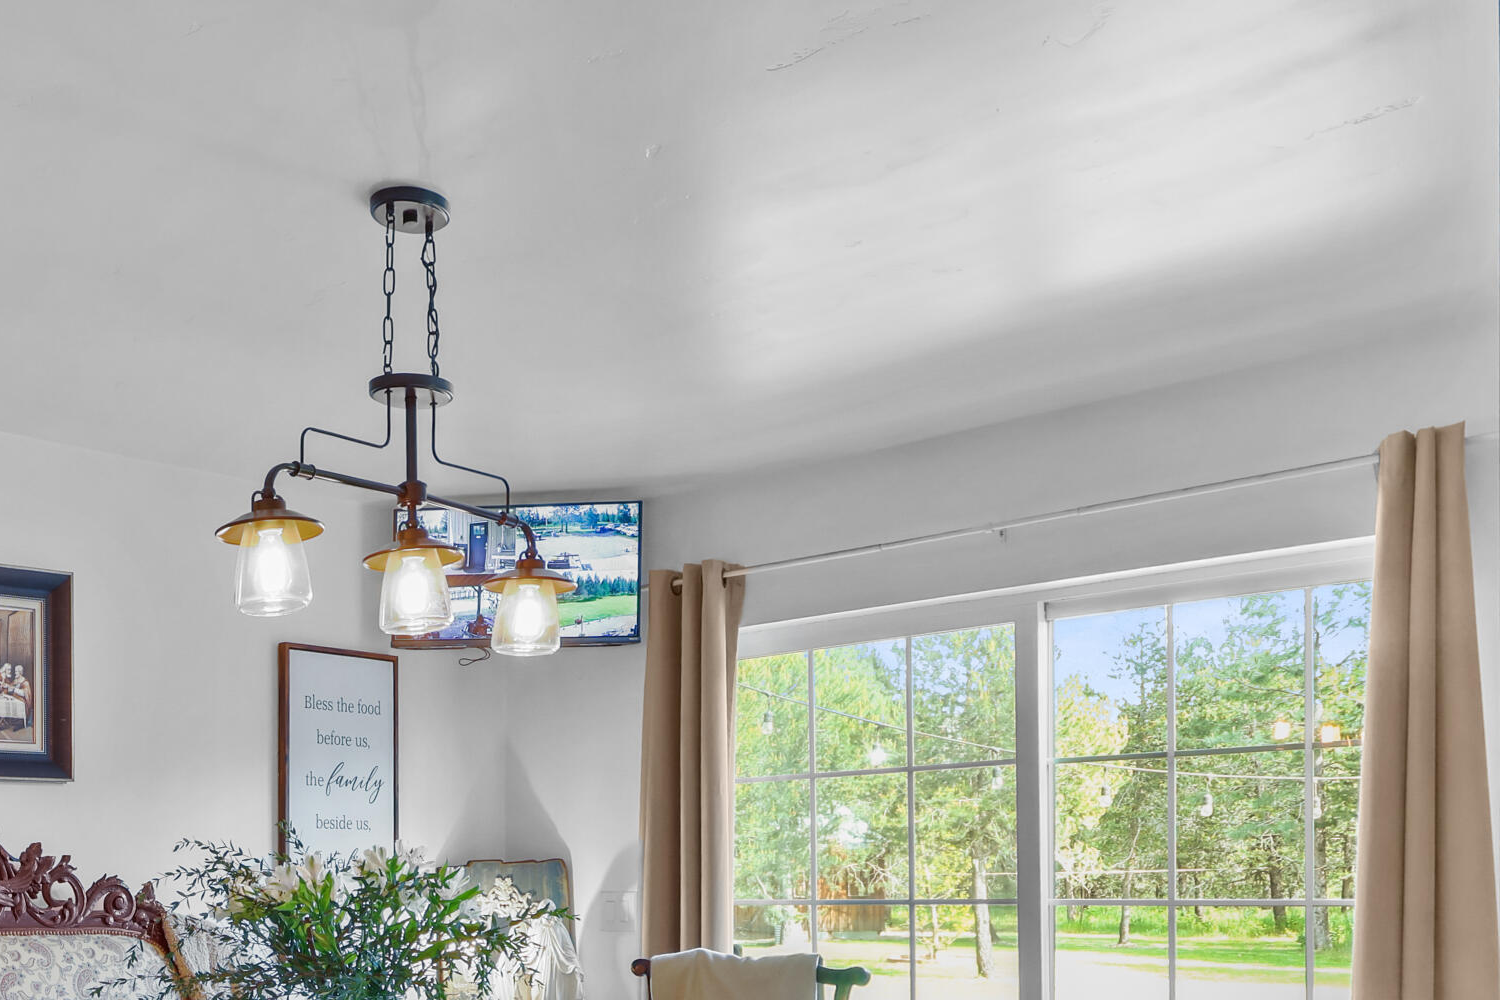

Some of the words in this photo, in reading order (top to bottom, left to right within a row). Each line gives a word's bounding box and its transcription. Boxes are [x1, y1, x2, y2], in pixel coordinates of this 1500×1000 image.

[304, 694, 333, 711] Bless
[337, 697, 354, 713] the
[357, 699, 381, 715] food
[317, 729, 351, 746] before
[355, 735, 370, 749] us,
[305, 771, 324, 787] the
[325, 762, 384, 804] family
[316, 814, 352, 829] beside
[357, 820, 371, 832] us,
